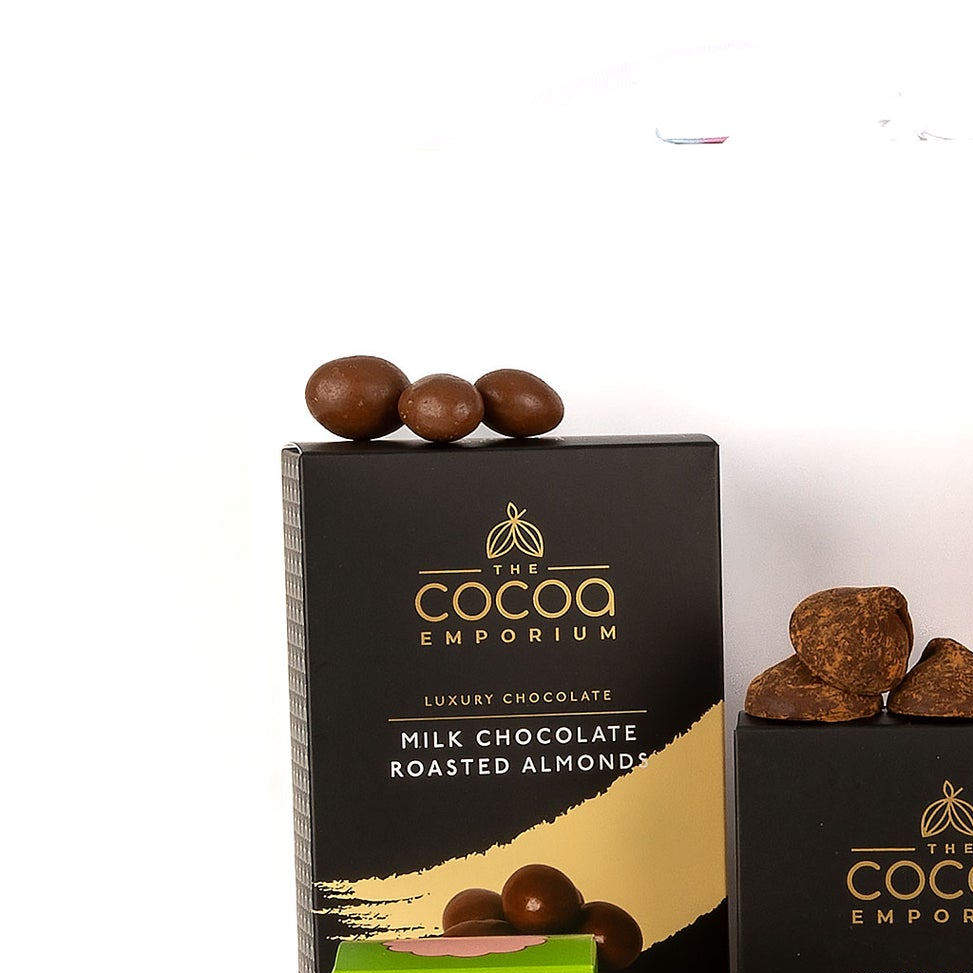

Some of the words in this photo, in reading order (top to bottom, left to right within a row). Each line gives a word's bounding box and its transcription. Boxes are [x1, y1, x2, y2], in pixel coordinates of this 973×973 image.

[493, 564, 537, 574] THE
[421, 626, 615, 645] EMPORIUM
[425, 694, 493, 706] LUXURY
[503, 690, 610, 703] CHOCOLATE
[402, 731, 462, 749] MILK
[477, 725, 636, 746] CHOCOLATE
[391, 758, 509, 777] ROASTED
[522, 753, 649, 774] ALMONDS
[928, 843, 973, 854] THE
